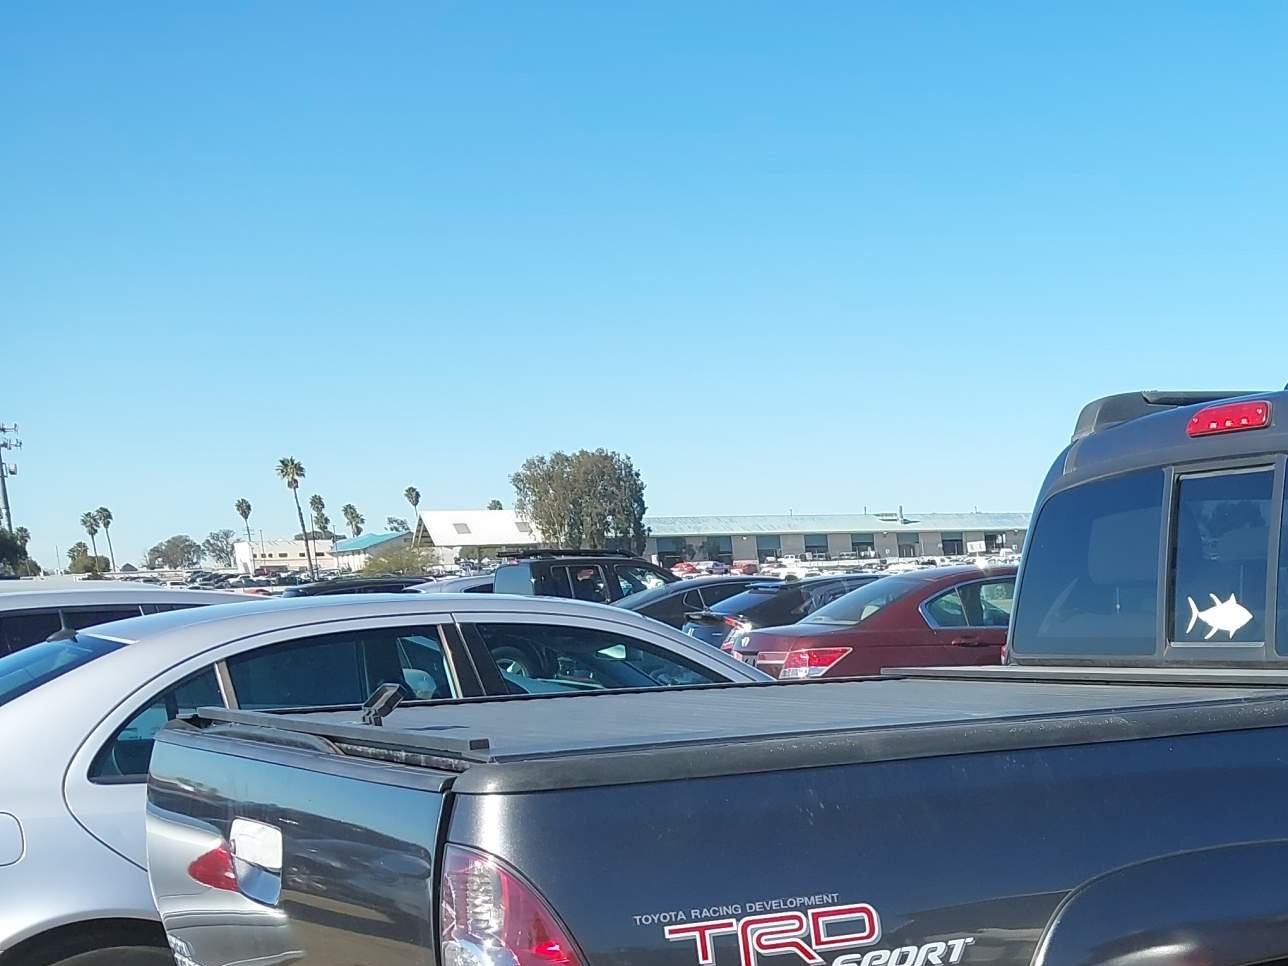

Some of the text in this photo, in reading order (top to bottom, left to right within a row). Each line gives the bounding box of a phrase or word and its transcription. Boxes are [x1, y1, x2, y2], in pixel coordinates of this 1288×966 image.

[633, 893, 839, 926] TOYOTA RACING DEVELOPMENT
